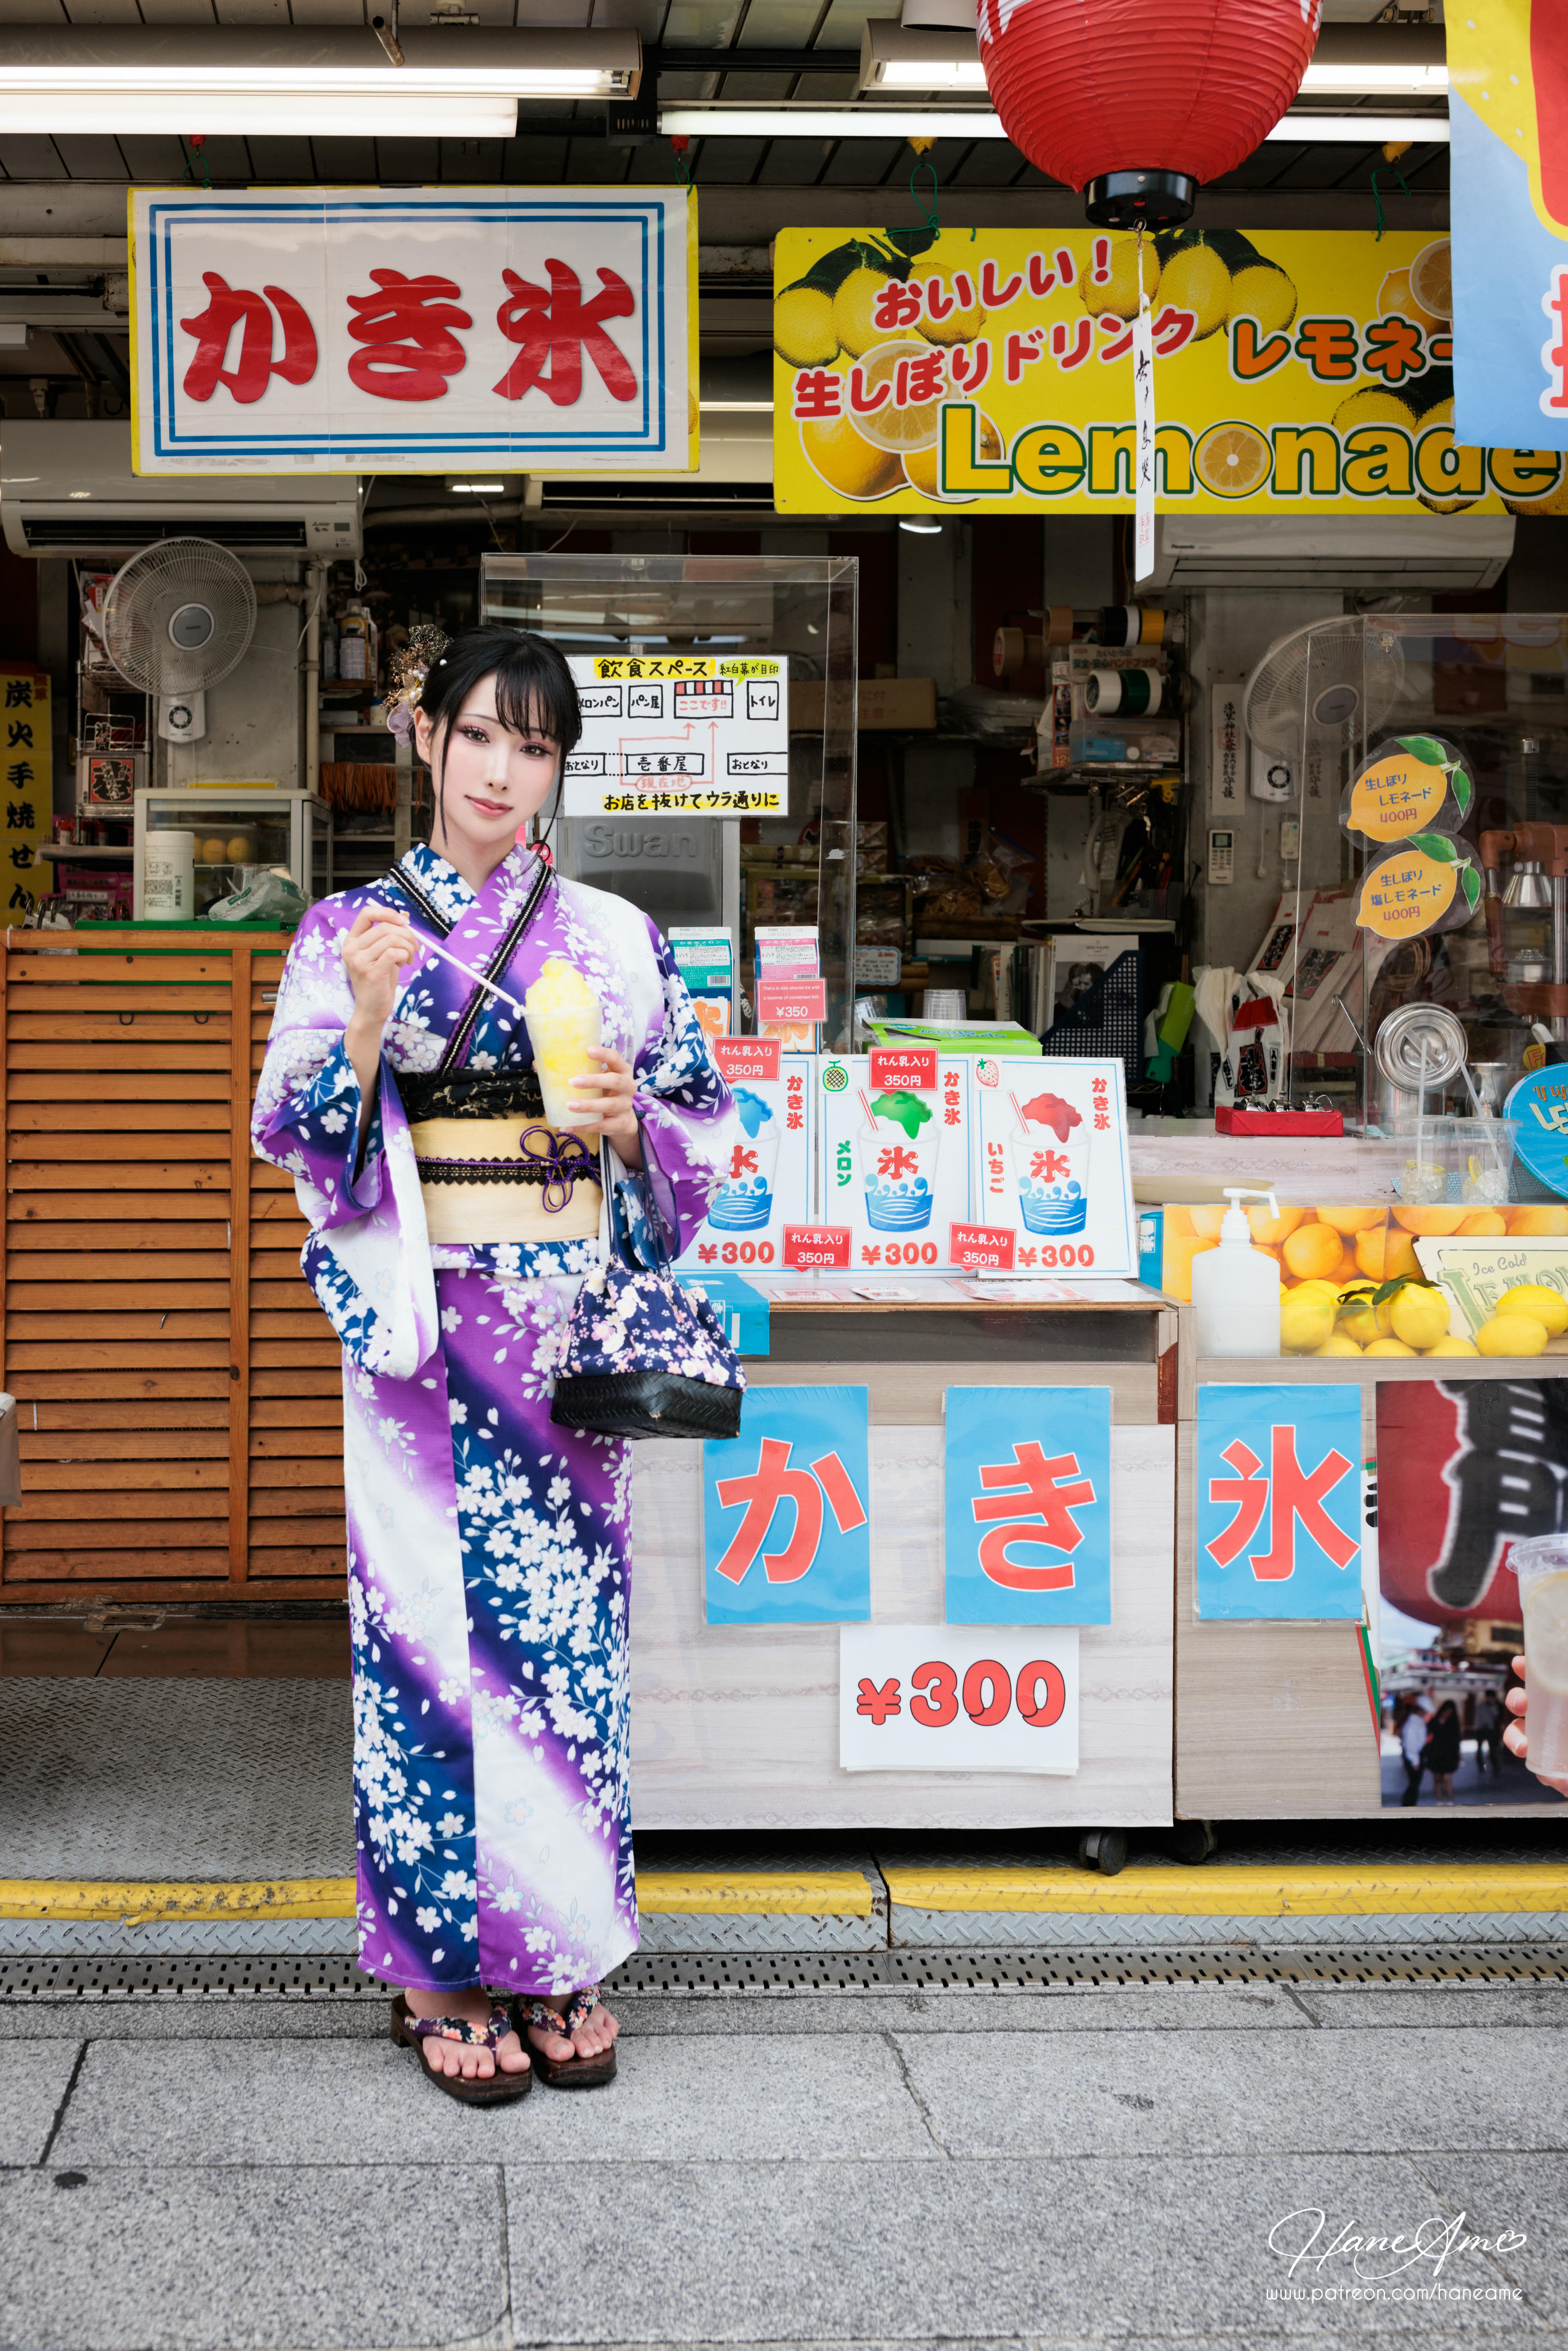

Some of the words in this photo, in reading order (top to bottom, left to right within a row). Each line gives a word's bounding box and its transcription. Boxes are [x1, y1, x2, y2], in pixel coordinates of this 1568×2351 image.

[180, 258, 638, 405] かき氷
[941, 404, 1561, 497] Lemonade
[597, 658, 708, 678] 飲食スペース
[720, 662, 779, 676] 紅白幕が目印
[631, 695, 660, 709] パン屋
[751, 695, 775, 708] トイレ
[565, 759, 598, 771] おとなり
[638, 755, 688, 772] 壱番屋
[732, 758, 768, 770] おとなり
[641, 777, 686, 789] 現在地
[1365, 773, 1407, 791] 生しぼり
[5, 680, 34, 909] 炭火手焼せん
[603, 790, 780, 811] お店を抜けてウラ通りに
[1379, 787, 1432, 806] レモネード
[1380, 808, 1418, 823] 400円
[584, 821, 698, 858] Swan
[1380, 870, 1423, 887] 生しぼり
[1371, 884, 1442, 906] 塩レモネード
[1383, 906, 1420, 921] 400円
[776, 1006, 808, 1017] ¥350
[720, 1045, 773, 1057] れん乳入り
[726, 1064, 763, 1076] 350円
[877, 1055, 930, 1068] れん乳入り
[884, 1074, 921, 1087] 350円
[944, 1071, 961, 1125] かき氷
[1532, 1085, 1547, 1101] If
[1550, 1084, 1568, 1100] lif
[787, 1076, 804, 1130] かき氷
[1092, 1077, 1111, 1130] かき氷
[1528, 1102, 1568, 1135] LE
[837, 1140, 852, 1186] メロン
[877, 1146, 919, 1180] 氷
[988, 1142, 1004, 1193] いちご
[1030, 1149, 1071, 1183] 氷
[791, 1232, 843, 1245] れん乳入り
[957, 1231, 1007, 1247] れん乳入り
[698, 1241, 774, 1264] ¥300
[797, 1252, 835, 1264] 350円
[861, 1242, 938, 1265] ¥300
[962, 1251, 999, 1266] 350円
[1018, 1244, 1095, 1267] ¥300
[1473, 1262, 1495, 1275] Ice
[1497, 1253, 1527, 1270] Cold
[715, 1436, 868, 1585] か
[971, 1440, 1098, 1593] き
[1205, 1424, 1361, 1582] 氷
[857, 1659, 1066, 1728] ¥300
